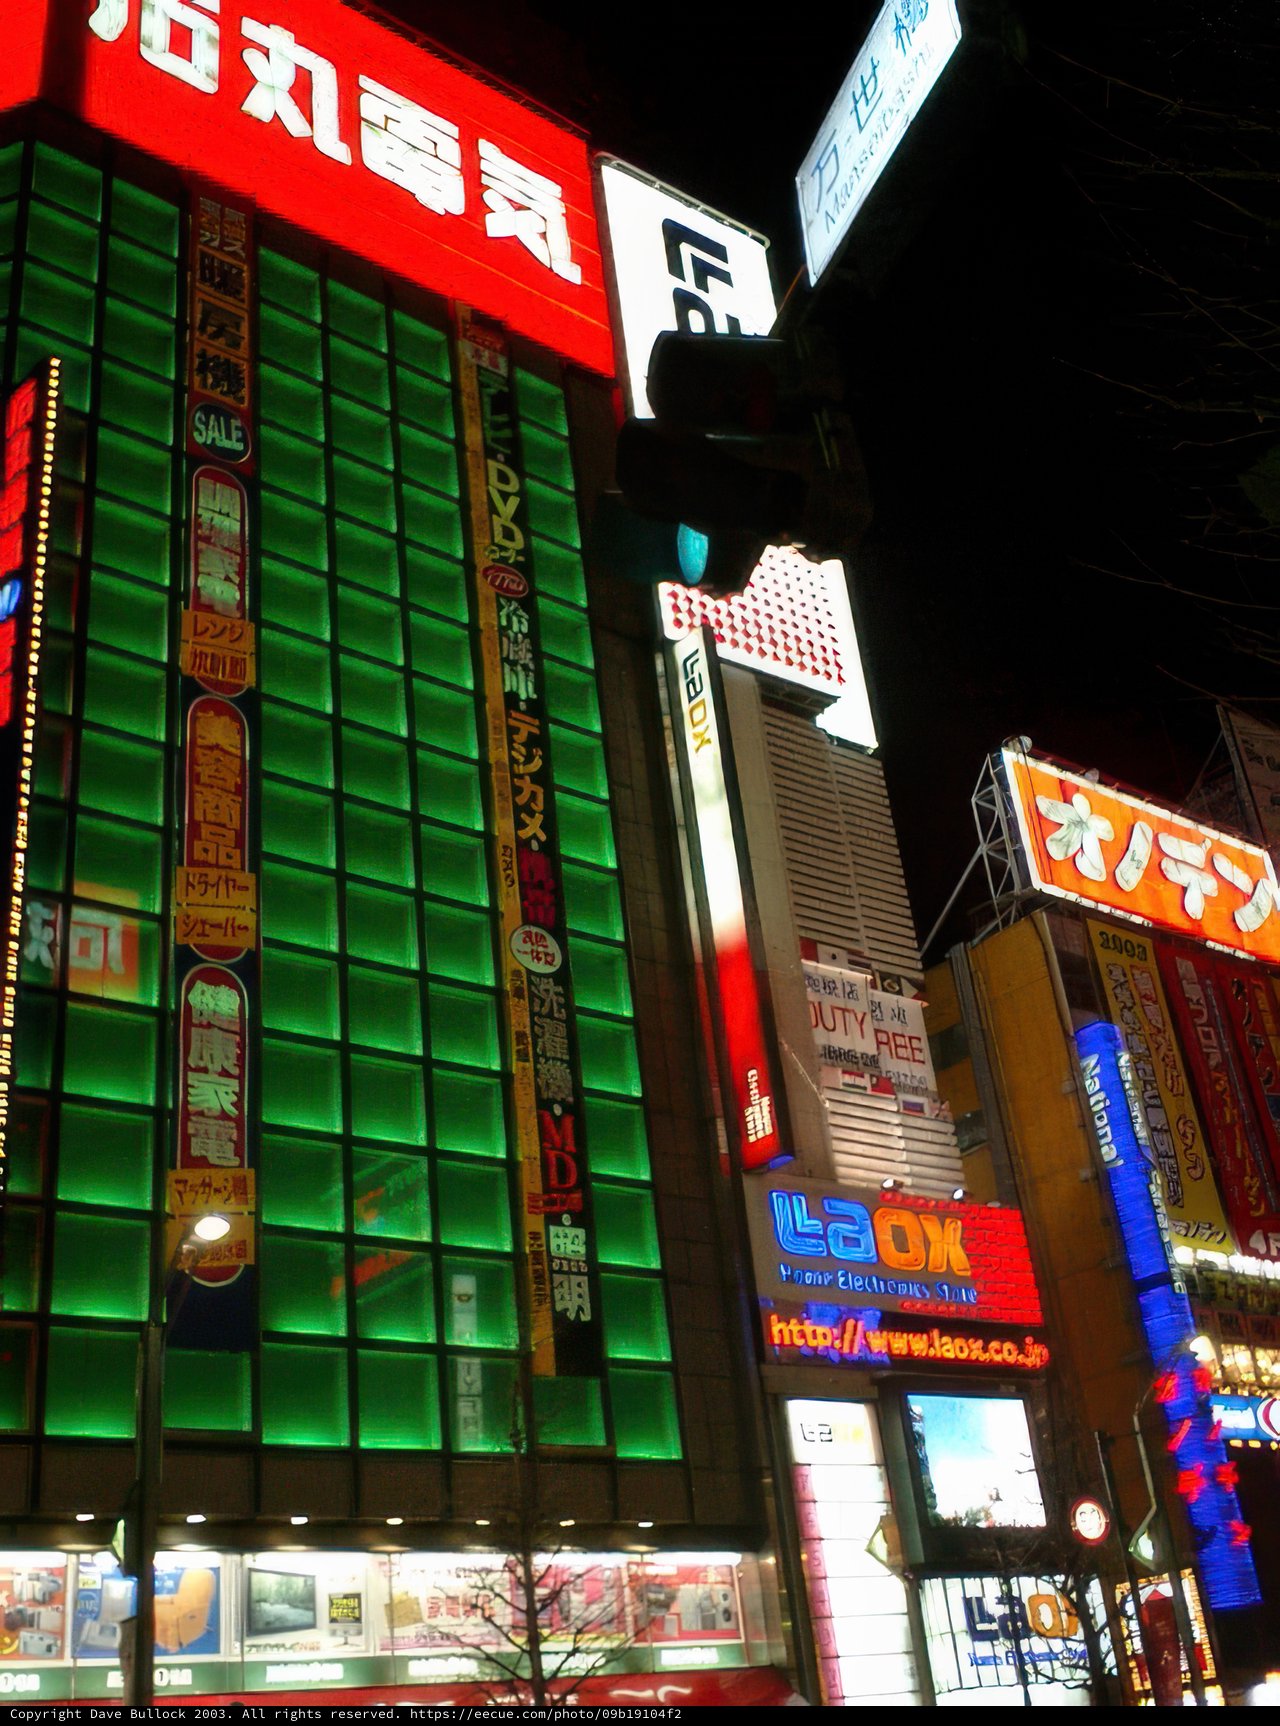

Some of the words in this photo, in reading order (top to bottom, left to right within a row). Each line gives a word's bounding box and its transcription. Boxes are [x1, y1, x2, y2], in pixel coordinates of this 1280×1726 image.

[88, 0, 582, 285] 石丸電気
[811, 0, 930, 213] 万世橋
[661, 217, 741, 336] La
[193, 408, 245, 451] SALE
[487, 458, 526, 552] DVD
[184, 872, 250, 899] ドライヤー
[530, 974, 575, 1102] 洗濯機
[873, 1028, 927, 1065] REE
[538, 1109, 578, 1190] MD
[1078, 1053, 1126, 1170] National
[768, 1312, 1050, 1369] http://www.laox.co.jp
